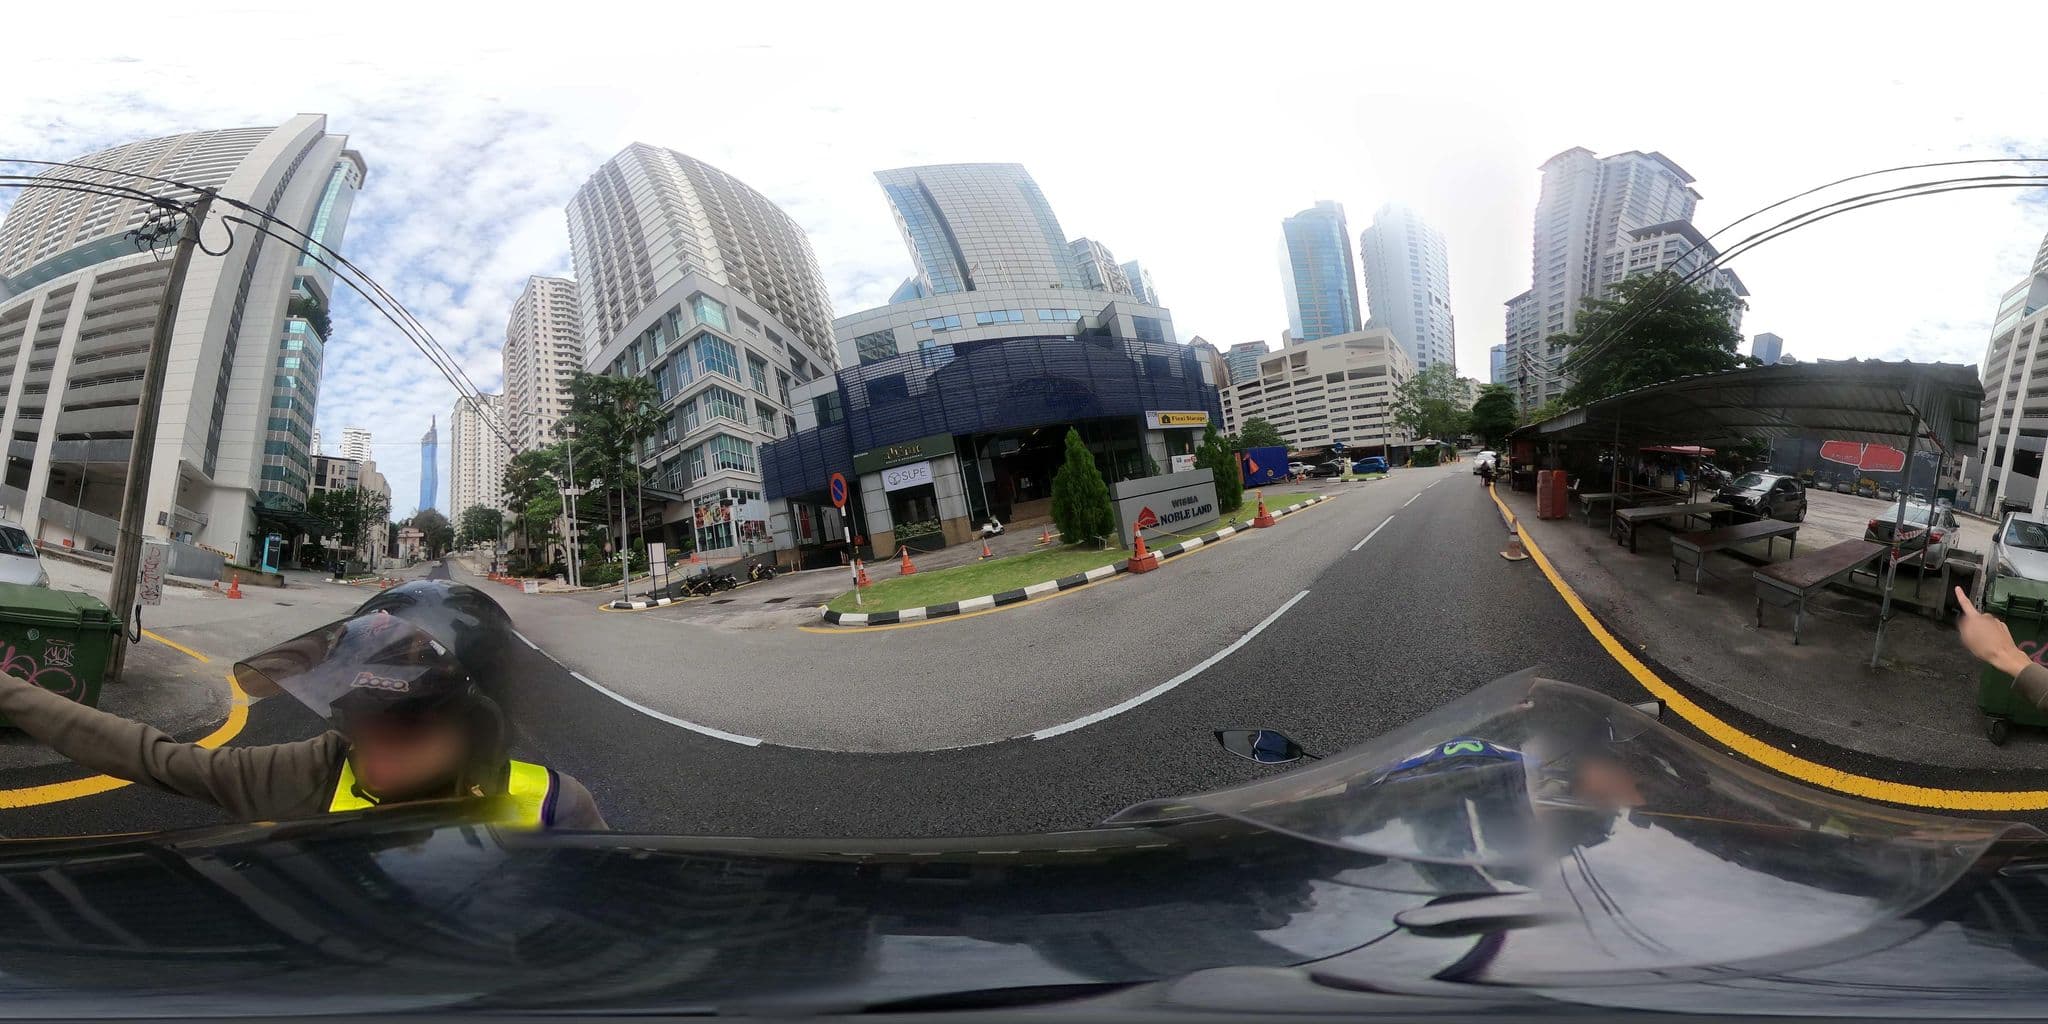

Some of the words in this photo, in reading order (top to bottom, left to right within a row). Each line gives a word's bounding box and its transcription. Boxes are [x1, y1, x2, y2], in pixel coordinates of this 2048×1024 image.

[1171, 496, 1198, 508] WISMA
[1160, 509, 1191, 525] NOBLE
[1192, 504, 1212, 517] LAND
